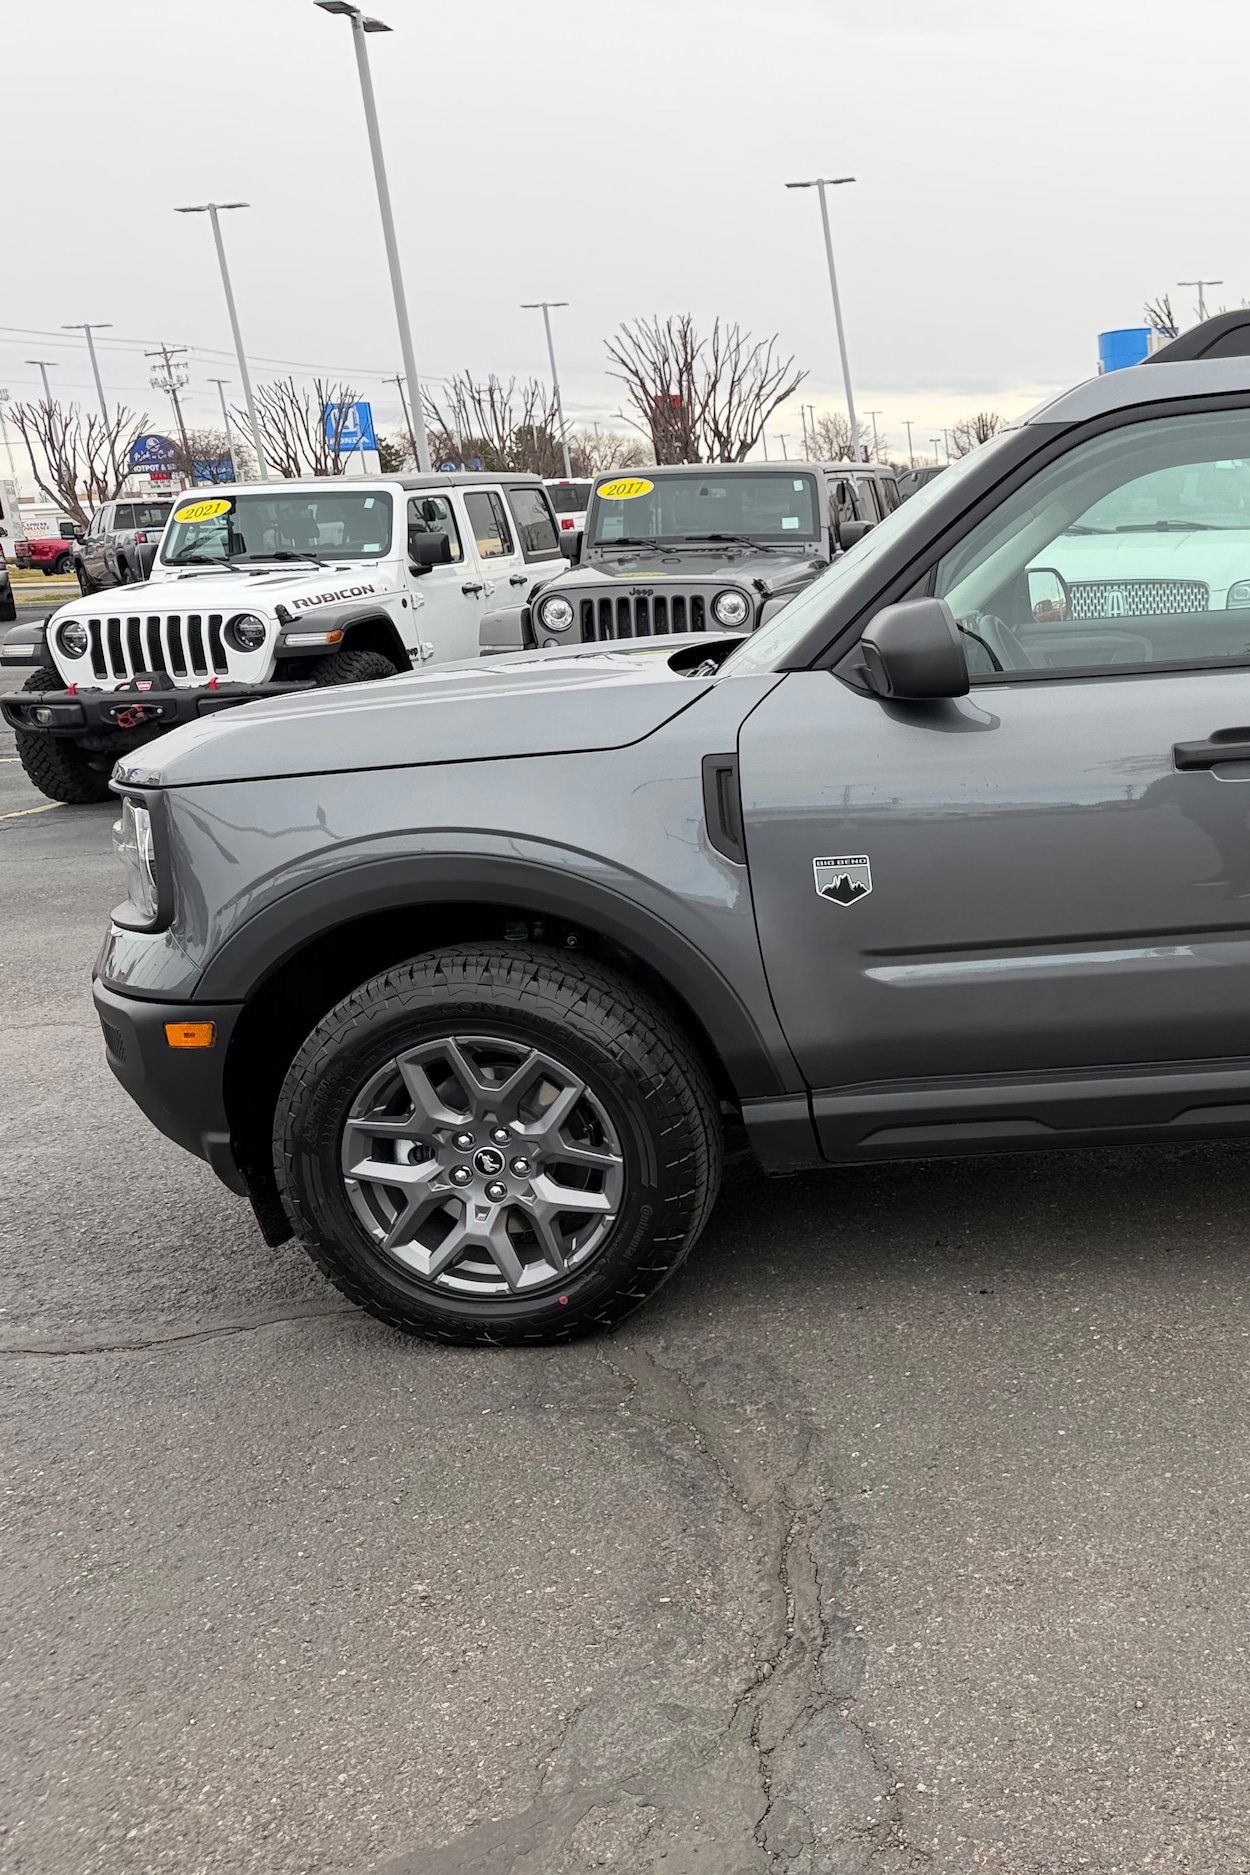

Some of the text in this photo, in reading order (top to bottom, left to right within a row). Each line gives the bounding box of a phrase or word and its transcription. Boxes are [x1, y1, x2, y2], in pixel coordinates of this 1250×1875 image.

[607, 482, 643, 496] 2017
[184, 503, 221, 520] 2021
[292, 584, 375, 609] RUBICON
[629, 587, 654, 596] Jeep
